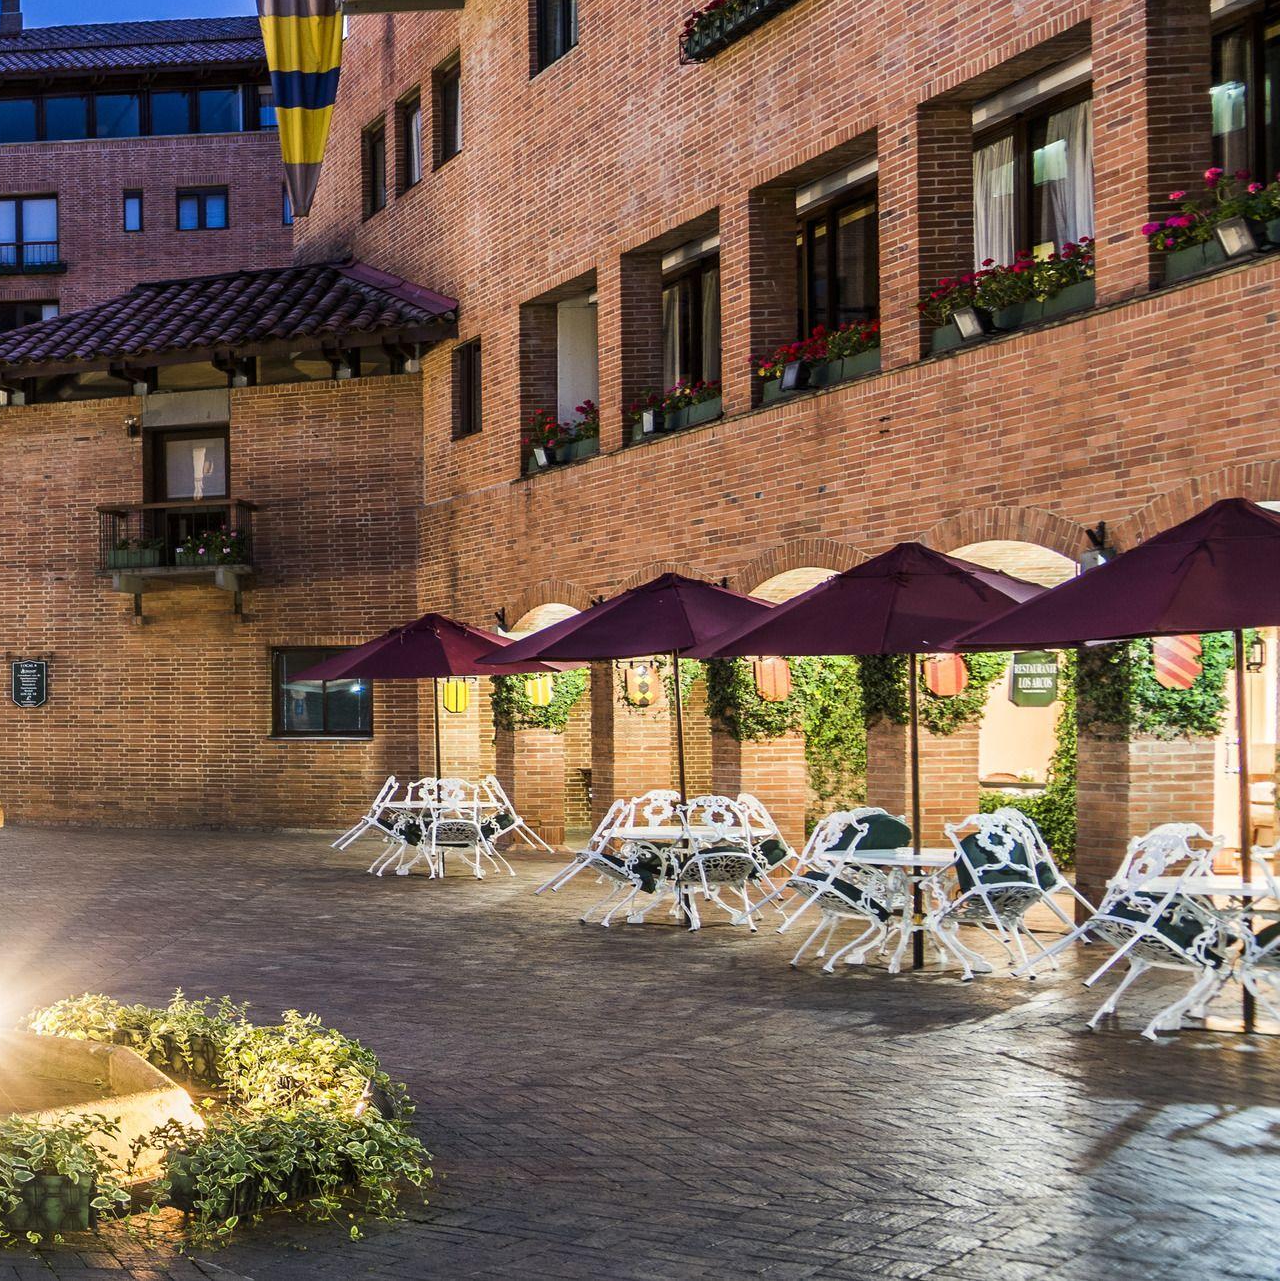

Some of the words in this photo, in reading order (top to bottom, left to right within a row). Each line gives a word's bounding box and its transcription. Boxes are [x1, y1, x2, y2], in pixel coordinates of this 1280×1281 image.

[1014, 663, 1057, 674] RESTAURANTE
[1018, 677, 1032, 688] LOS
[1032, 677, 1053, 688] ARCOS
